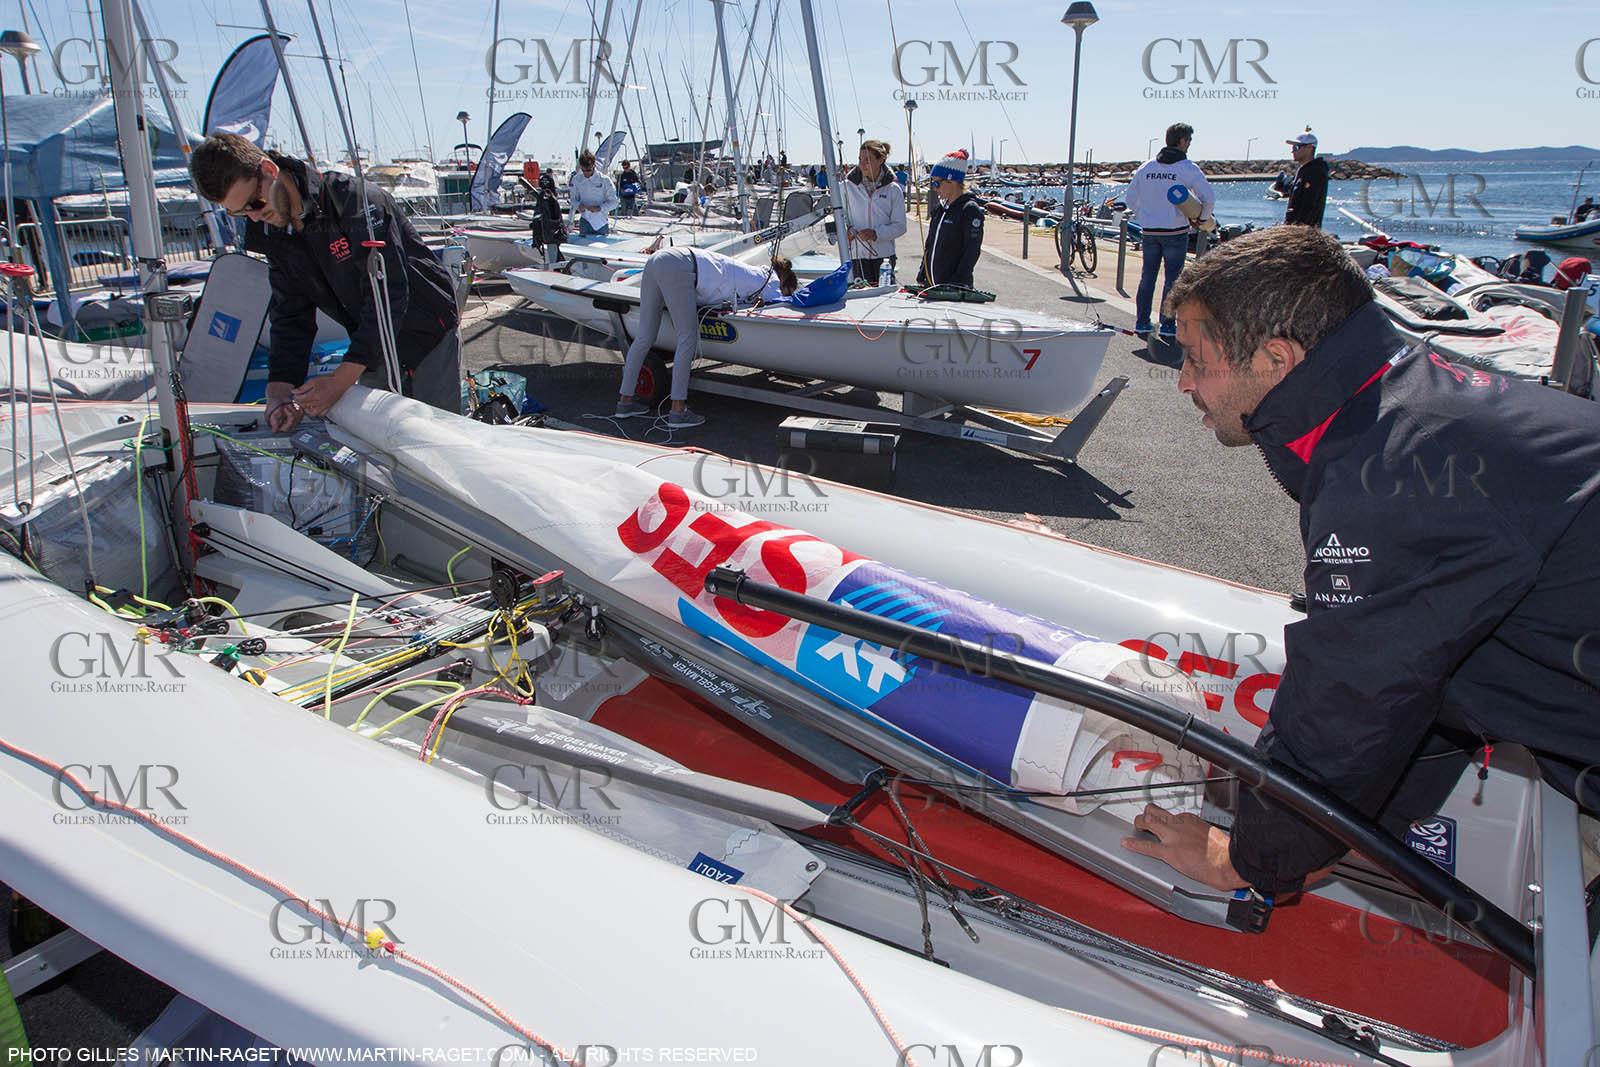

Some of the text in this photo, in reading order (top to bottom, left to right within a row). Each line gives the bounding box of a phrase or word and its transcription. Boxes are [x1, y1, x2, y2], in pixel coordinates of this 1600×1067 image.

[1146, 172, 1177, 181] FRANCE
[329, 237, 349, 255] SFS
[1023, 349, 1041, 370] 7
[672, 660, 727, 696] ZIEGELMAYER
[530, 733, 626, 765] high technology
[545, 731, 628, 757] ZIEGELMAYER
[1411, 841, 1447, 856] ISAF
[695, 862, 734, 885] ZAOLI
